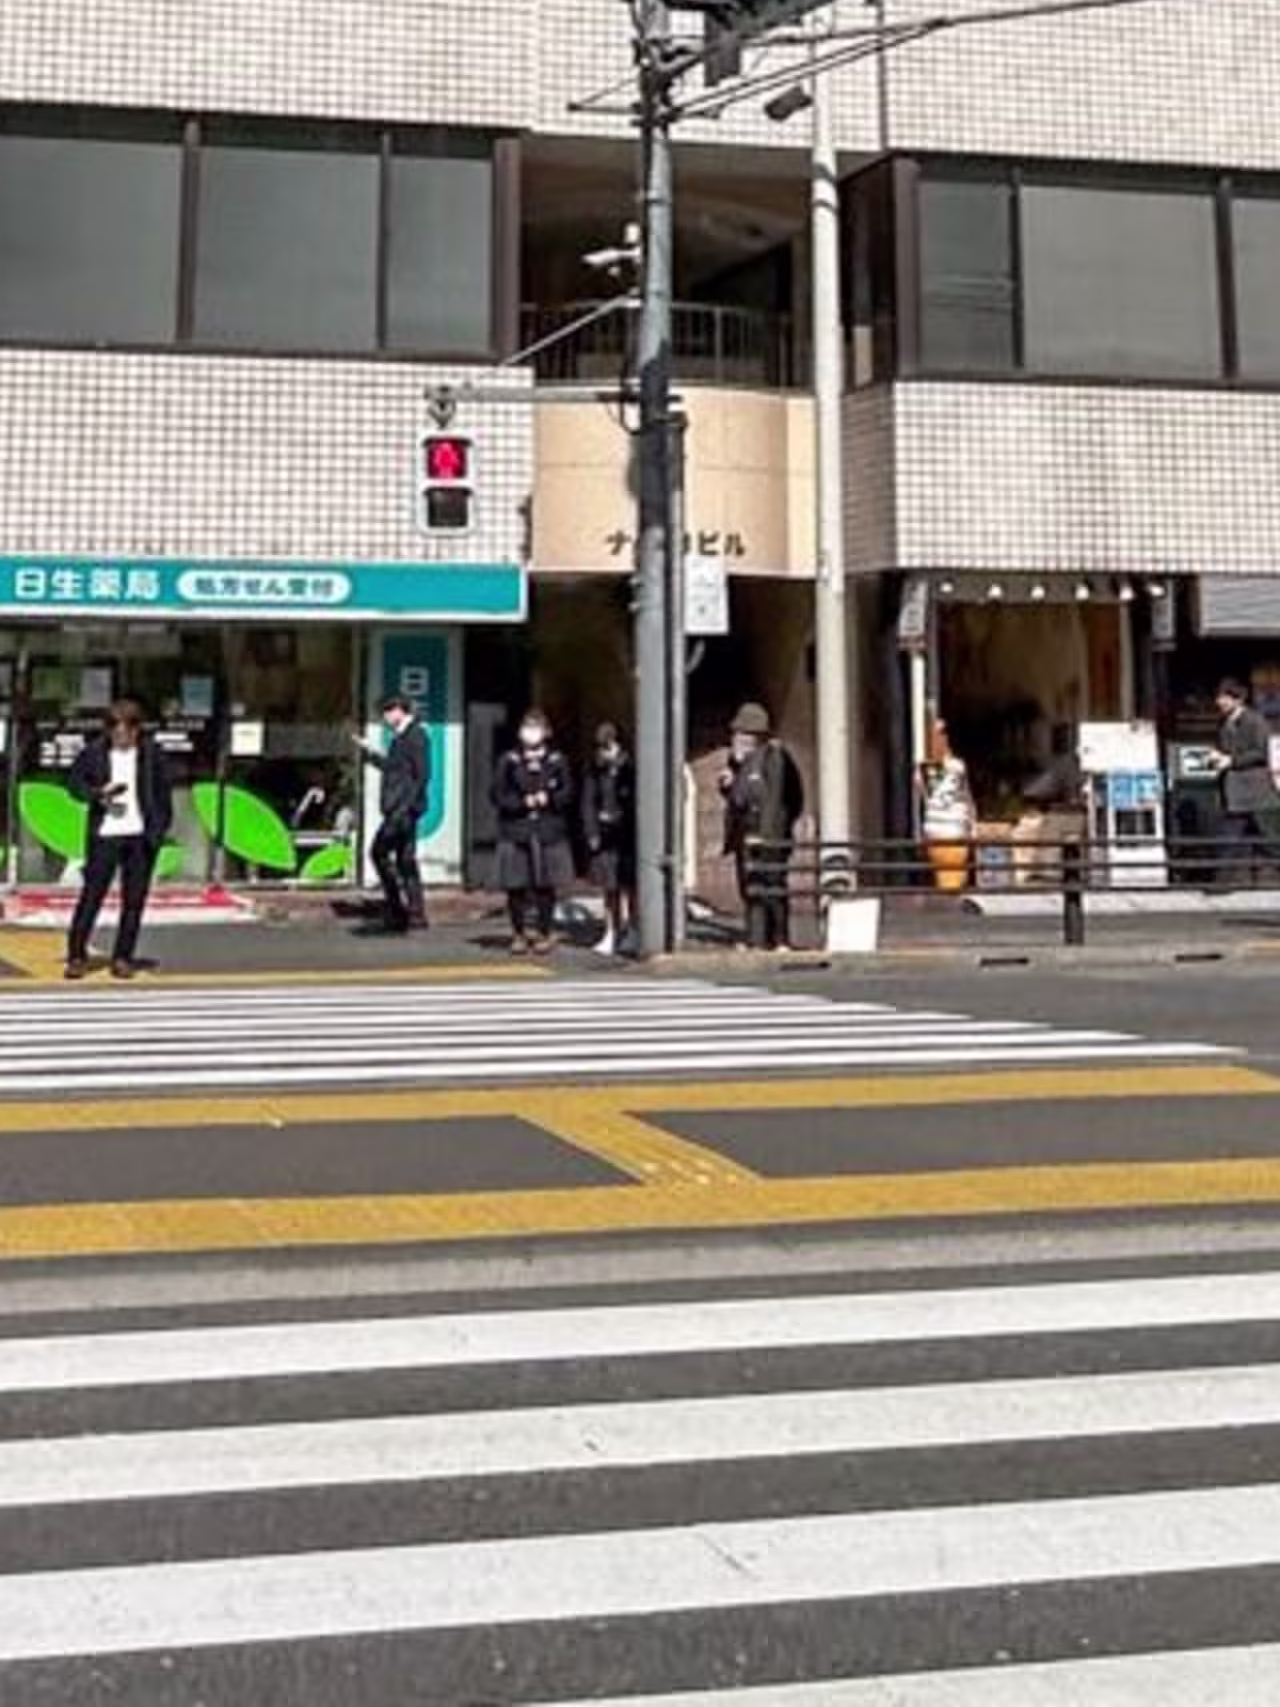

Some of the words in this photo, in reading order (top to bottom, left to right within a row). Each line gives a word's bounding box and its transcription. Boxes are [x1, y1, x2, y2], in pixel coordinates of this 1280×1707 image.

[606, 530, 745, 556] ナビル
[15, 568, 161, 600] 日生薬局
